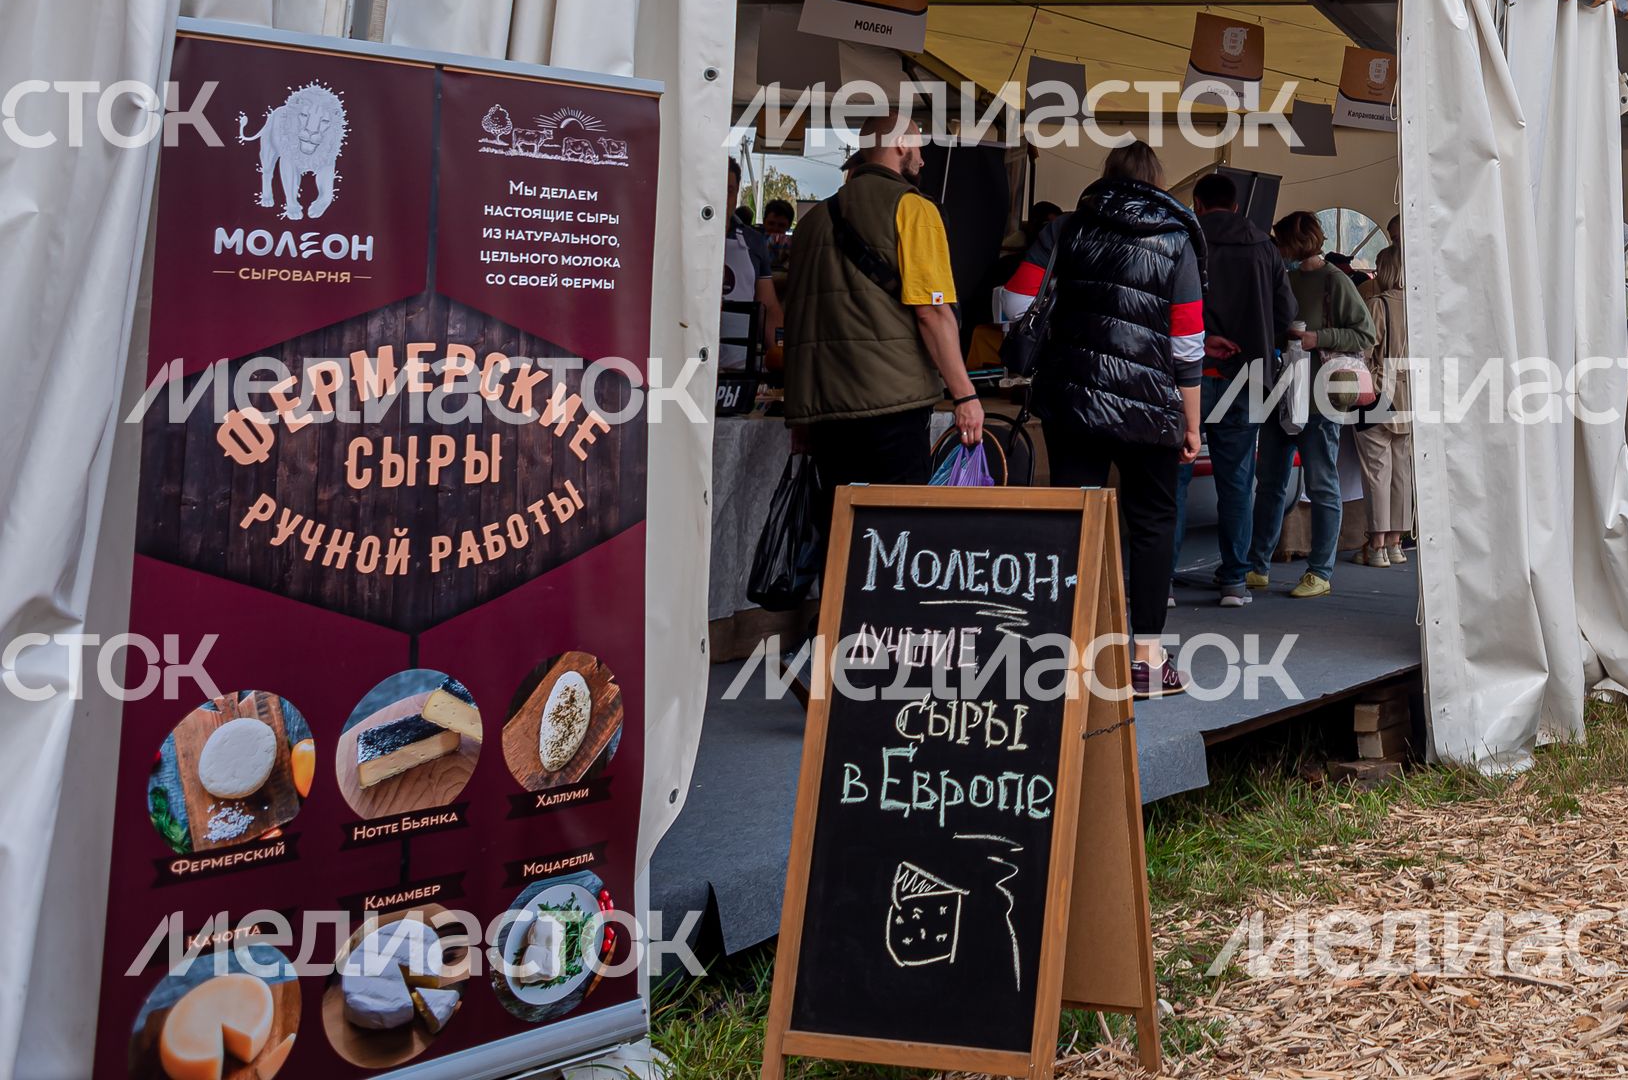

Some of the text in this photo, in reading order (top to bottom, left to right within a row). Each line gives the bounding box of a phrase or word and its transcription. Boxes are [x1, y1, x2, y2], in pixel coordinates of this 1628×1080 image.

[854, 19, 893, 35] МОЛЕОН
[509, 180, 598, 201] МЫ ДЕЛАЕМ
[484, 205, 619, 225] НАСТОЯЩИЕ СЫРЫ
[214, 227, 374, 261] МОЛЕОН
[482, 228, 620, 248] ИЗ НАТУРАЛЬНОГО,
[480, 250, 621, 269] ЦЕЛЬНОГО МОЛОКА
[238, 268, 351, 283] СЫРОВАРНЯ
[485, 273, 615, 289] СО СВОЕЙ ФЕРМЫ
[215, 342, 611, 467] ФЕРМЕРСКИЕ
[345, 434, 503, 490] СЫРЫ
[238, 479, 585, 576] РУЧНОЙ РАБОТЫ
[850, 621, 983, 673] ЛУЧШИЕ
[896, 693, 1030, 751] СЫРЫ
[535, 785, 590, 809] ХАЛЛУМИ
[353, 811, 458, 841] НОТТЕ БЬЯНКА
[170, 840, 286, 877] ФЕРМЕРСКИЙ
[522, 850, 595, 877] МОЦАРЕЛЛА
[364, 884, 441, 911] КАМАМБЕР
[187, 925, 261, 950] КАЧОТТА
